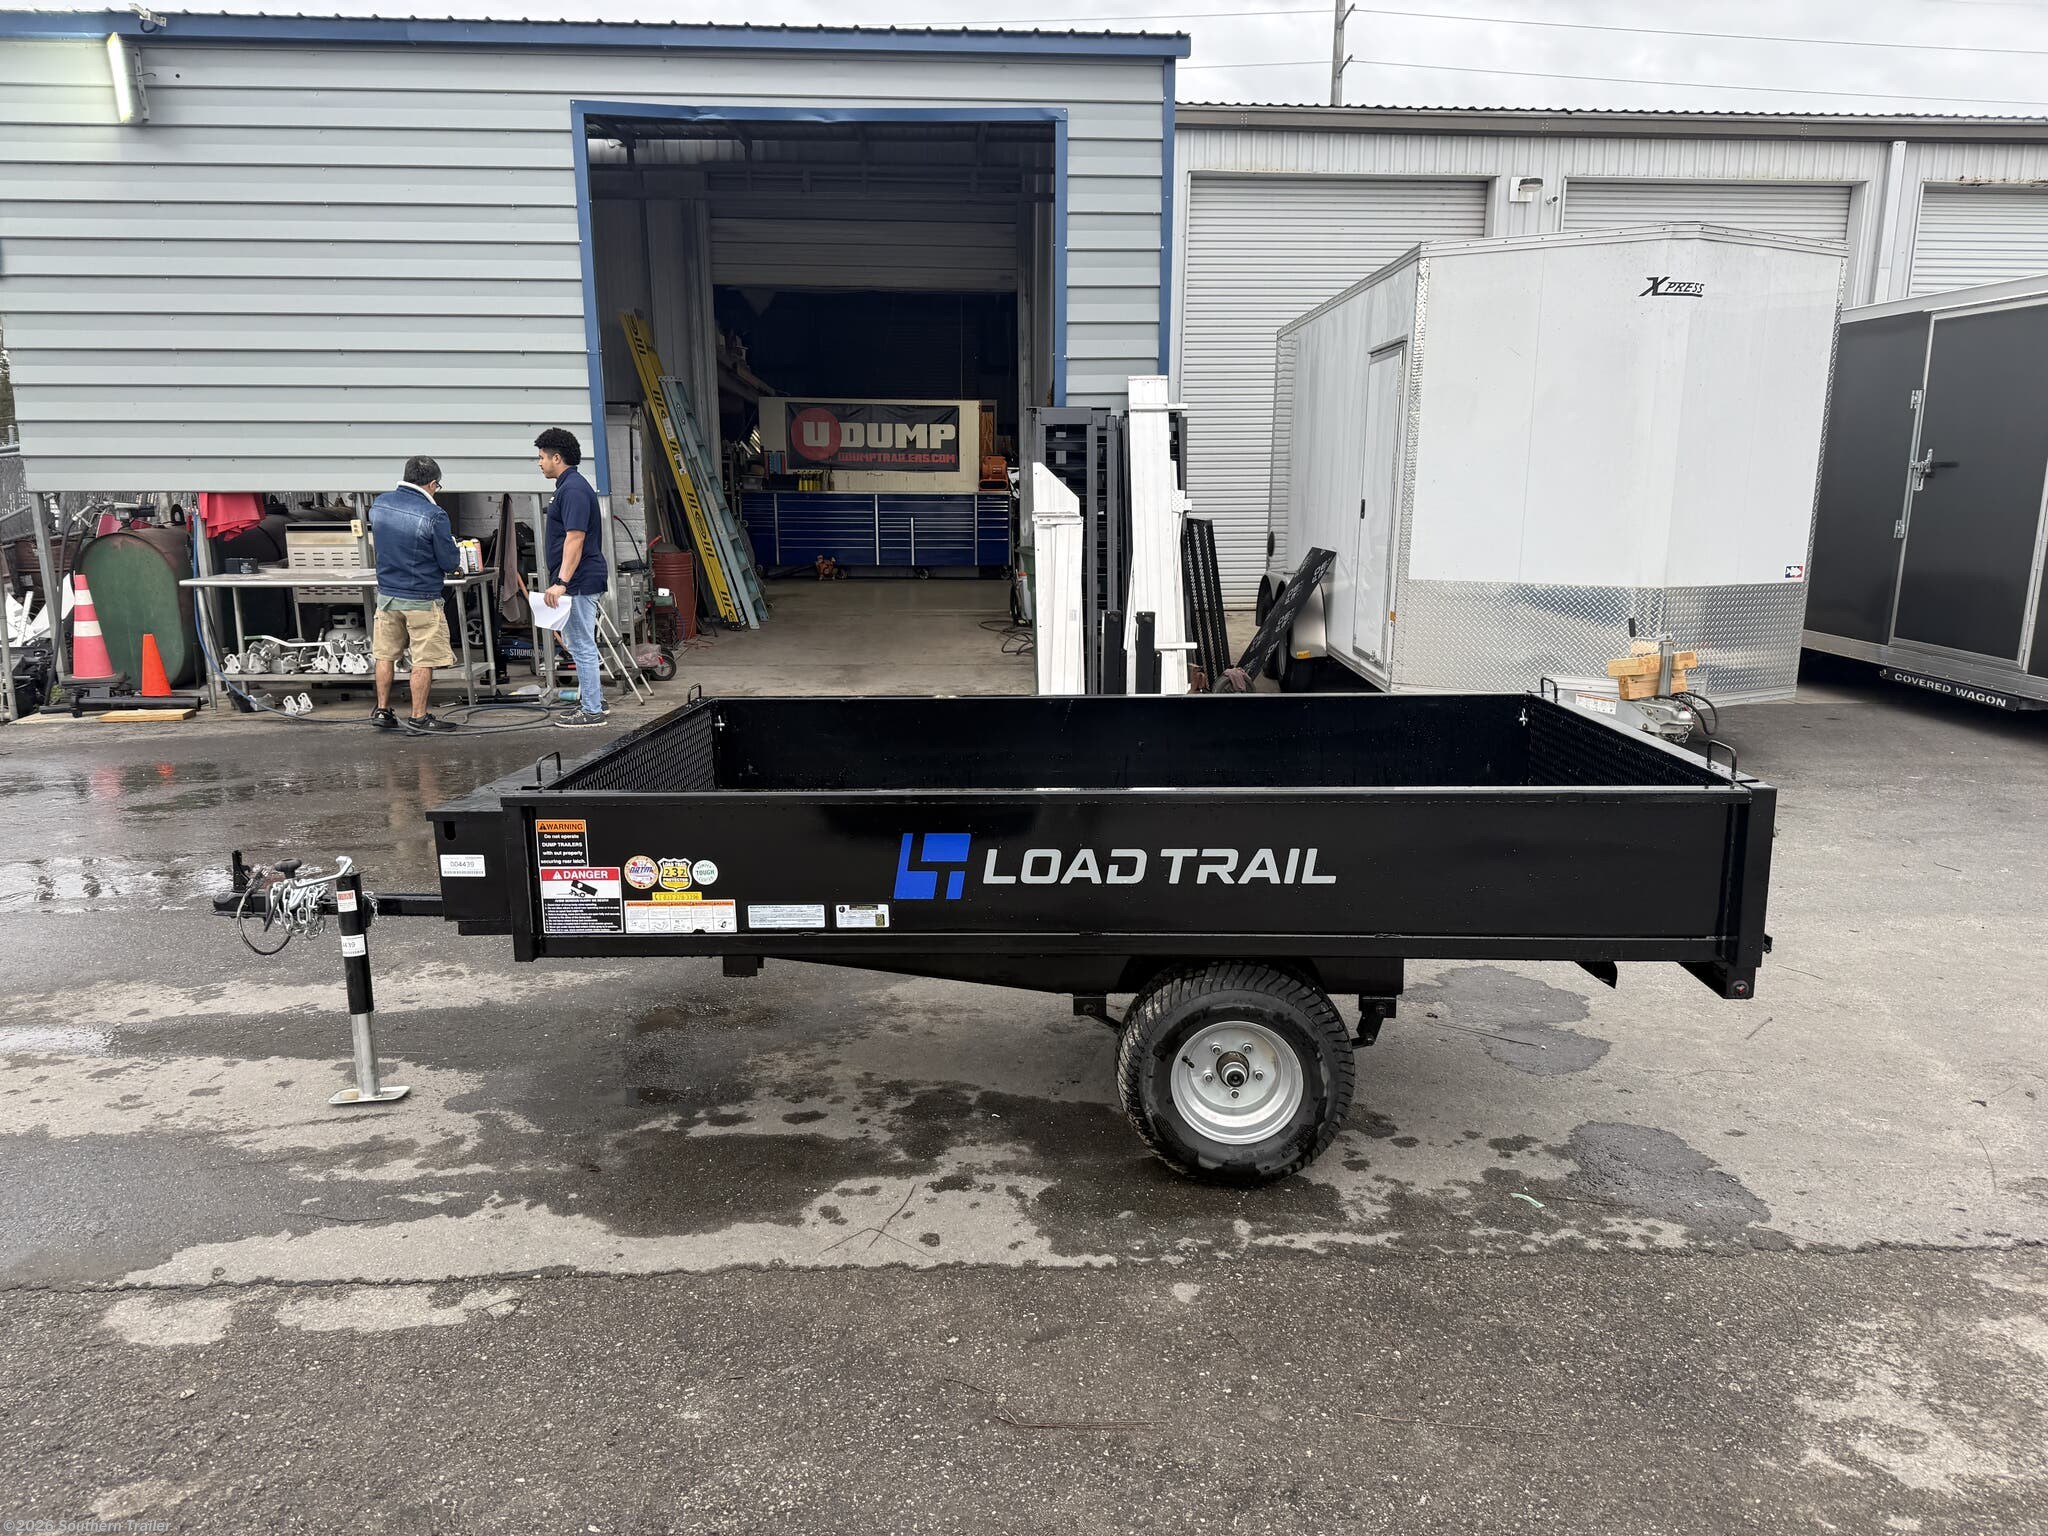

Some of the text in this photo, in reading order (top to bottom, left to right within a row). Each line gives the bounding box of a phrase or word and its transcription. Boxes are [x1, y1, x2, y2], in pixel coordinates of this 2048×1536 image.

[1638, 276, 1705, 298] XPRESS
[1894, 673, 2007, 707] COVERED WAGON
[546, 823, 583, 831] WARNING
[563, 870, 608, 880] DANGER
[983, 848, 1147, 885] LOAD
[1159, 848, 1337, 885] TRAIL
